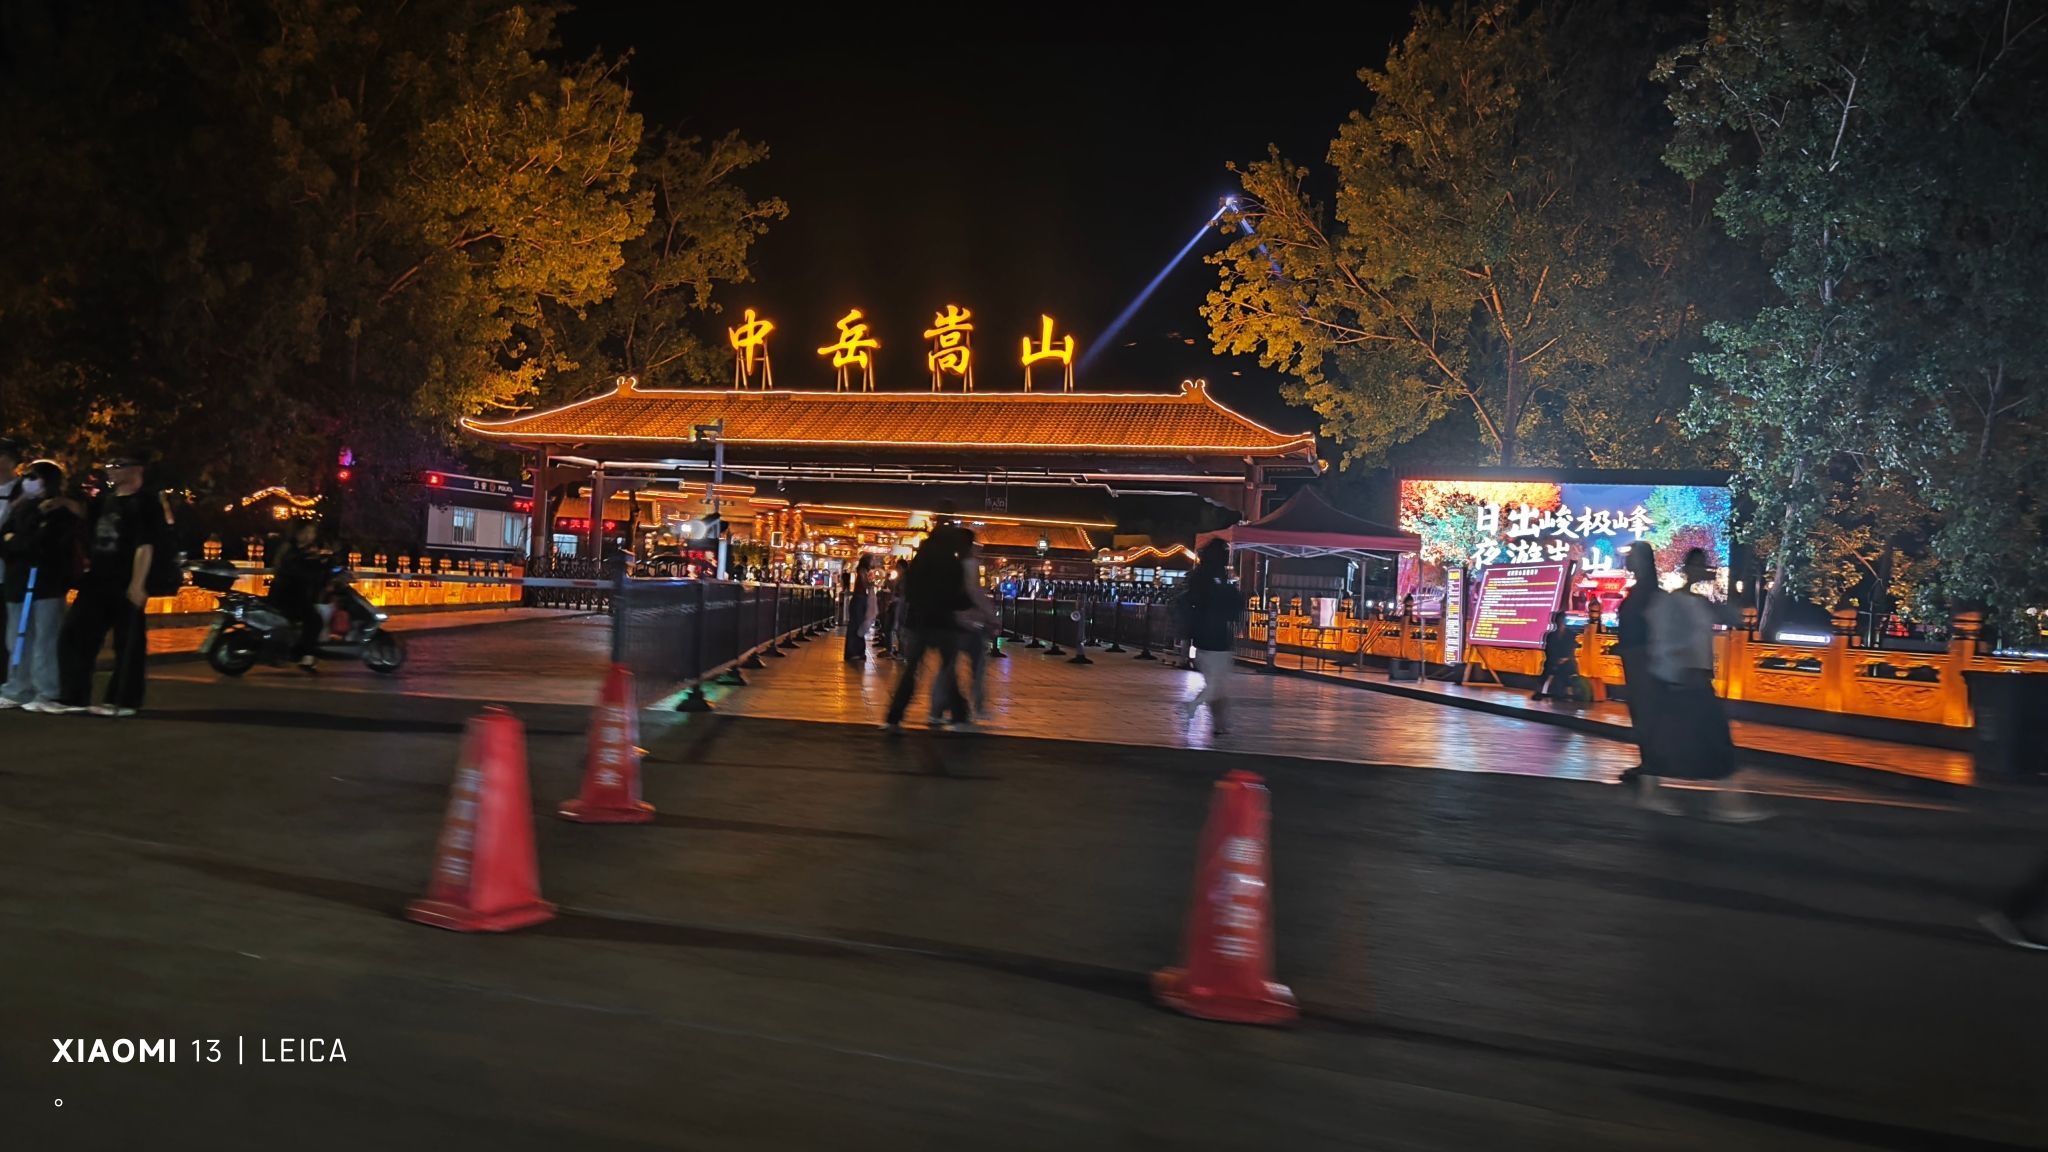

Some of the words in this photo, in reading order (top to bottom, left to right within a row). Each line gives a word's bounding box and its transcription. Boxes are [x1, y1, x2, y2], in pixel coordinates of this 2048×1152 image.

[729, 305, 1075, 375] 中岳嵩山
[1476, 503, 1654, 540] 日出峻极峰
